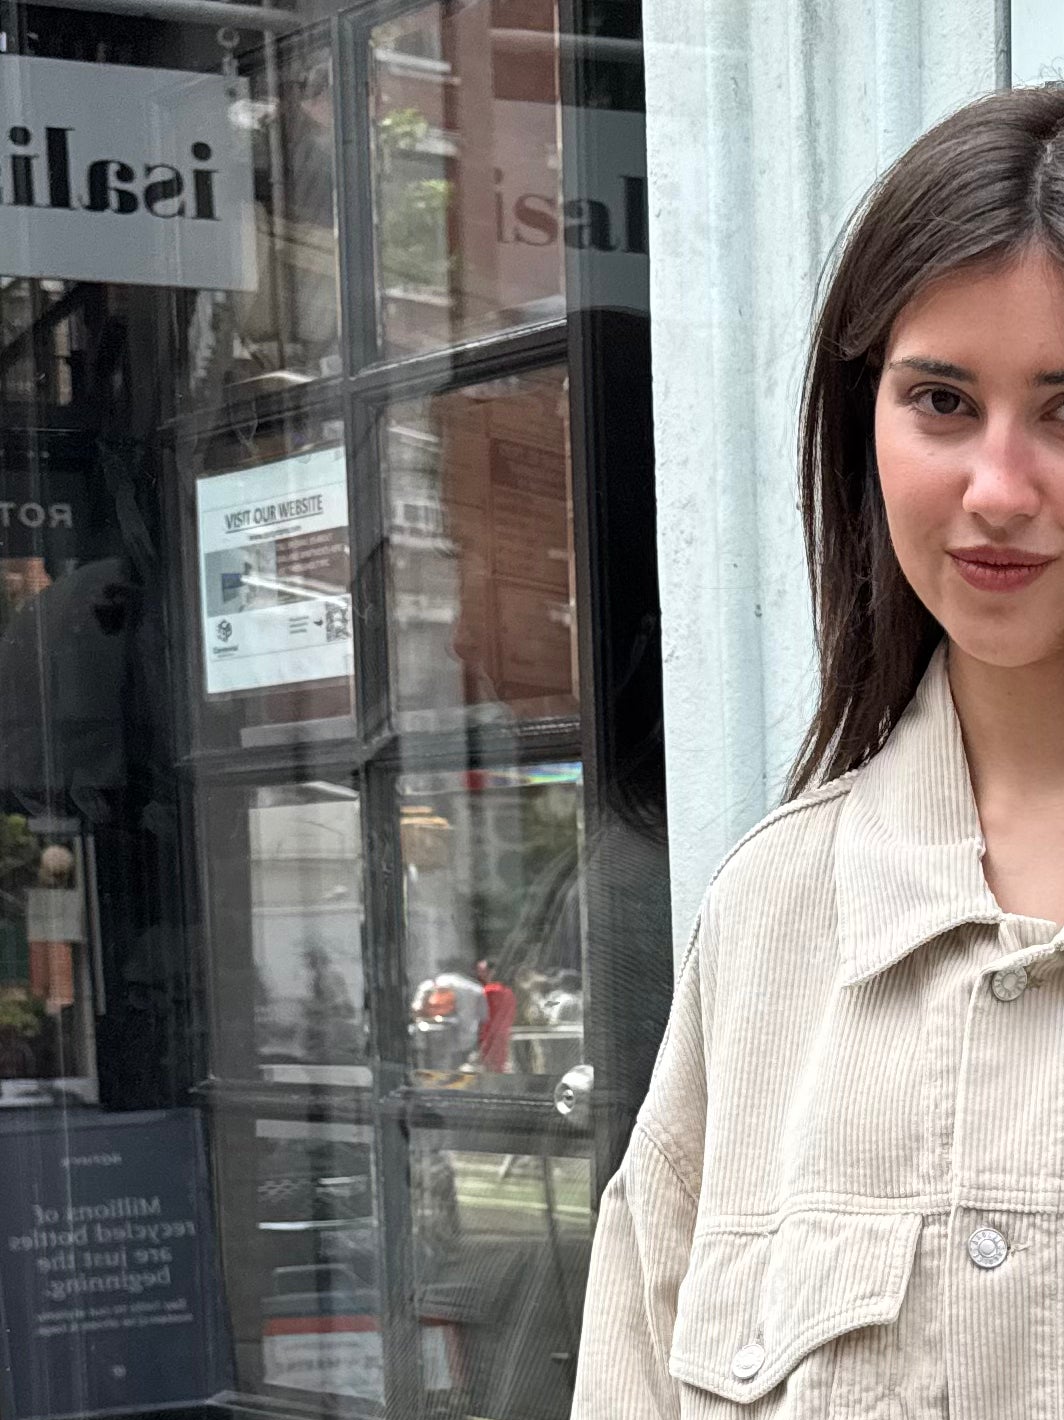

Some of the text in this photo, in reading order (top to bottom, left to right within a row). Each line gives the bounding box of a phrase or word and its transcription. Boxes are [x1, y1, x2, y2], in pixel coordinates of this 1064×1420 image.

[224, 493, 323, 530] VISIT OUR WEBSITE
